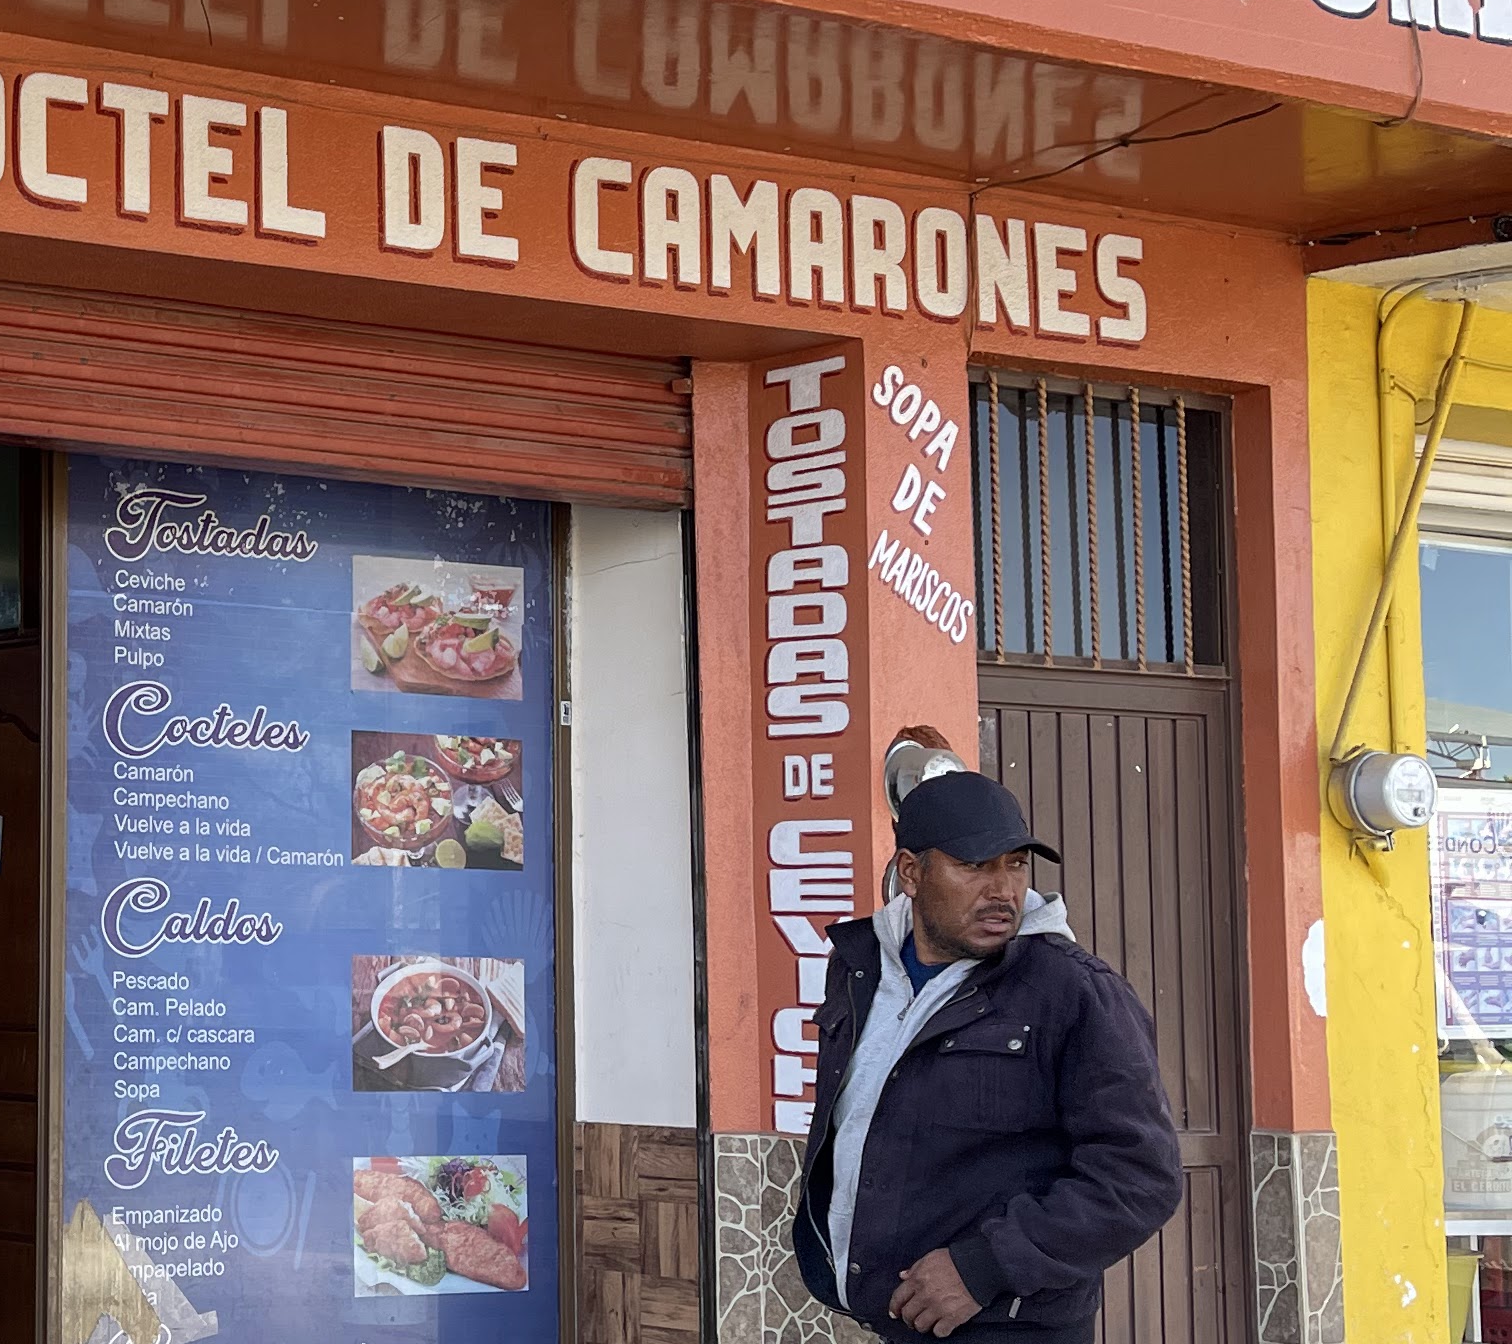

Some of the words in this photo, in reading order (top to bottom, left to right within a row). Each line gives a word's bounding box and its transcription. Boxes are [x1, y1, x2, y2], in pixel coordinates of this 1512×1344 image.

[379, 125, 519, 268] DE
[570, 157, 1148, 346] CAMARONES
[871, 363, 961, 473] SOPA
[892, 463, 947, 537] DE
[105, 489, 317, 562] Tostadas
[765, 355, 850, 739] TOSTADAS
[115, 570, 186, 591] Ceviche
[869, 528, 975, 645] MARISCOS
[113, 594, 193, 617] Camarón
[114, 620, 171, 641] Mixtas
[114, 646, 164, 669] Pulpo
[103, 680, 310, 759] Cocteles
[113, 761, 194, 784] Camarón
[783, 754, 834, 801] DE
[113, 787, 229, 811] Campechano
[114, 814, 176, 835] Vuelve
[179, 821, 190, 835] a
[195, 818, 210, 835] la
[213, 818, 251, 837] vida
[114, 841, 176, 861] Vuelve
[179, 846, 190, 861] a
[194, 843, 210, 862] la
[213, 844, 252, 863] vida
[256, 847, 262, 863] /
[266, 846, 344, 867] Camarón
[101, 877, 283, 959] Caldos
[112, 971, 189, 991] Pescado
[112, 998, 159, 1017] Cam.
[165, 998, 226, 1018] Pelado
[113, 1025, 161, 1044] Cam.
[166, 1025, 182, 1044] c/
[187, 1027, 255, 1044] cascara
[113, 1052, 231, 1075] Campechano
[114, 1080, 160, 1102] Sopa
[104, 1109, 279, 1189] Filetes
[112, 1204, 222, 1228] Empanizado
[114, 1233, 130, 1252] Al
[136, 1232, 178, 1255] mojo
[184, 1231, 206, 1250] de
[210, 1230, 238, 1253] Ajo
[128, 1258, 225, 1282] mpapelado
